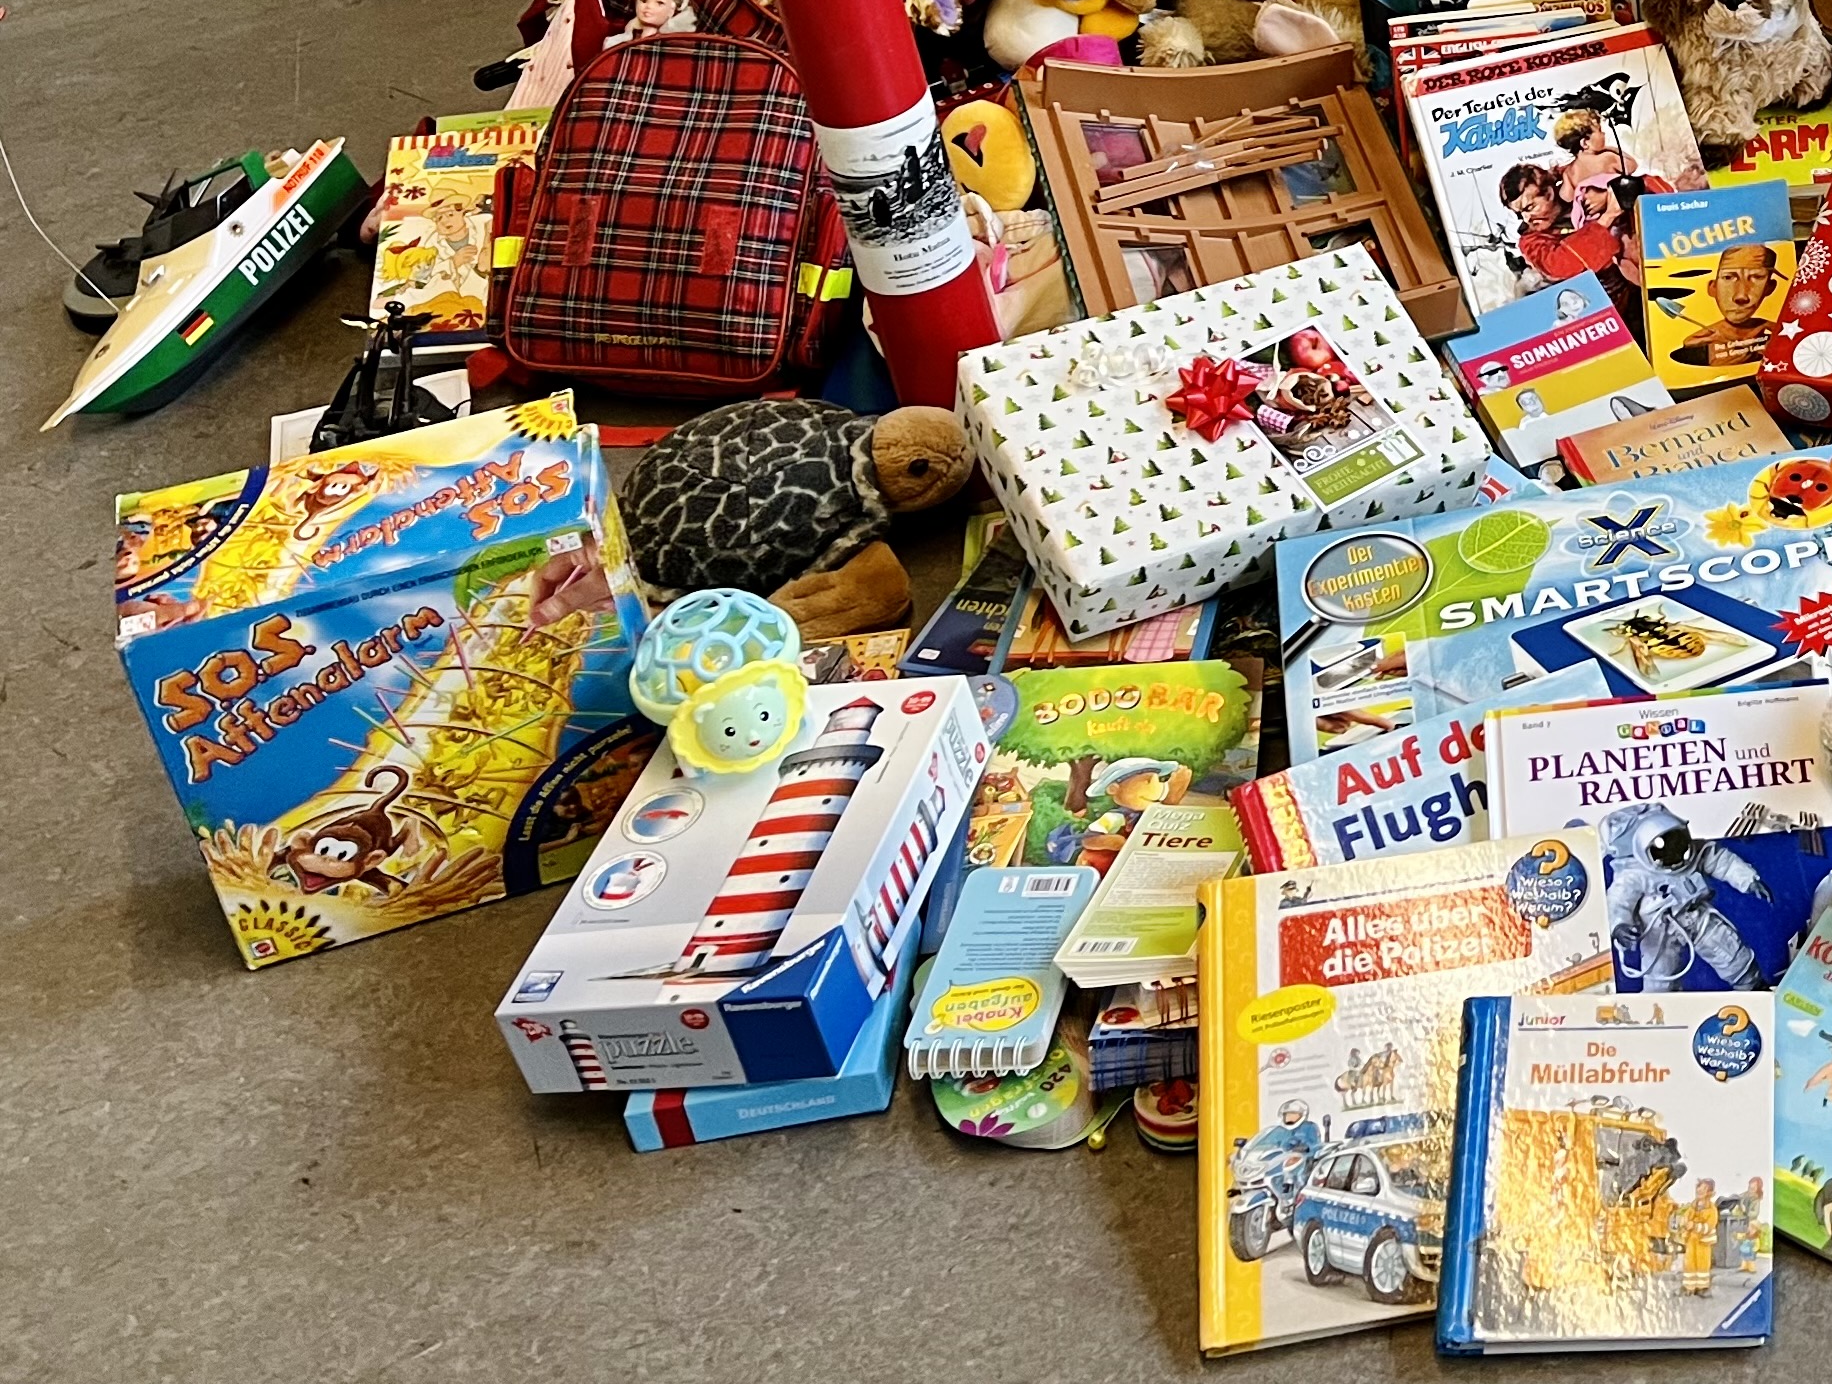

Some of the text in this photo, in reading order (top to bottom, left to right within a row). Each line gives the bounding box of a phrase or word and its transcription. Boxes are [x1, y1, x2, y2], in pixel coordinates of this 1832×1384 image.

[1422, 40, 1609, 93] DER ROTE KORSAR
[1430, 86, 1555, 123] Der Teufel der
[1758, 114, 1799, 126] STER
[1439, 103, 1548, 160] Karibik
[1729, 123, 1830, 173] LARM
[282, 147, 325, 194] NOTRUF 110
[1656, 199, 1710, 213] Louis Sachar
[238, 203, 315, 286] POLIZEI
[1657, 215, 1757, 260] LÖCHER
[1509, 316, 1620, 370] SOMNIAVERO
[1602, 412, 1752, 469] Bernard
[1678, 445, 1705, 462] und
[1314, 465, 1352, 490] FROHE
[312, 450, 525, 568] Affenalarm
[1576, 520, 1677, 548] Science
[1346, 544, 1374, 566] Der
[1306, 554, 1426, 598] Experimentier
[1341, 583, 1402, 612] kasten
[156, 612, 317, 734] S.O.S.
[184, 605, 446, 784] Affenalarm
[1032, 683, 1143, 726] BODO
[1522, 721, 1543, 730] Band
[1638, 705, 1680, 720] Wissen
[1336, 734, 1424, 806] Auf
[1528, 737, 1772, 783] PLANETEN und
[1578, 757, 1815, 807] RAUMFAHRT
[1146, 818, 1193, 833] Quiz
[1151, 807, 1206, 822] Mega
[1331, 771, 1488, 862] Flugh
[1140, 831, 1214, 849] Tiere
[1510, 887, 1583, 904] Weshalb?
[1514, 900, 1574, 915] Warum?
[237, 916, 312, 954] CLASSIC
[1322, 902, 1489, 947] Alles über
[1321, 927, 1493, 980] die Polizei
[944, 991, 1034, 1013] aufgaben
[955, 1005, 1024, 1027] Knobel
[599, 1030, 700, 1065] puzzle
[1586, 1041, 1617, 1058] Die
[1697, 1044, 1756, 1062] Weshalb?
[1706, 1035, 1751, 1049] Wieso?
[1039, 1062, 1073, 1093] 420
[1530, 1060, 1672, 1085] Müllabfuhr
[1699, 1055, 1749, 1071] Warum?
[736, 1093, 836, 1120] DEUTSCHLAND
